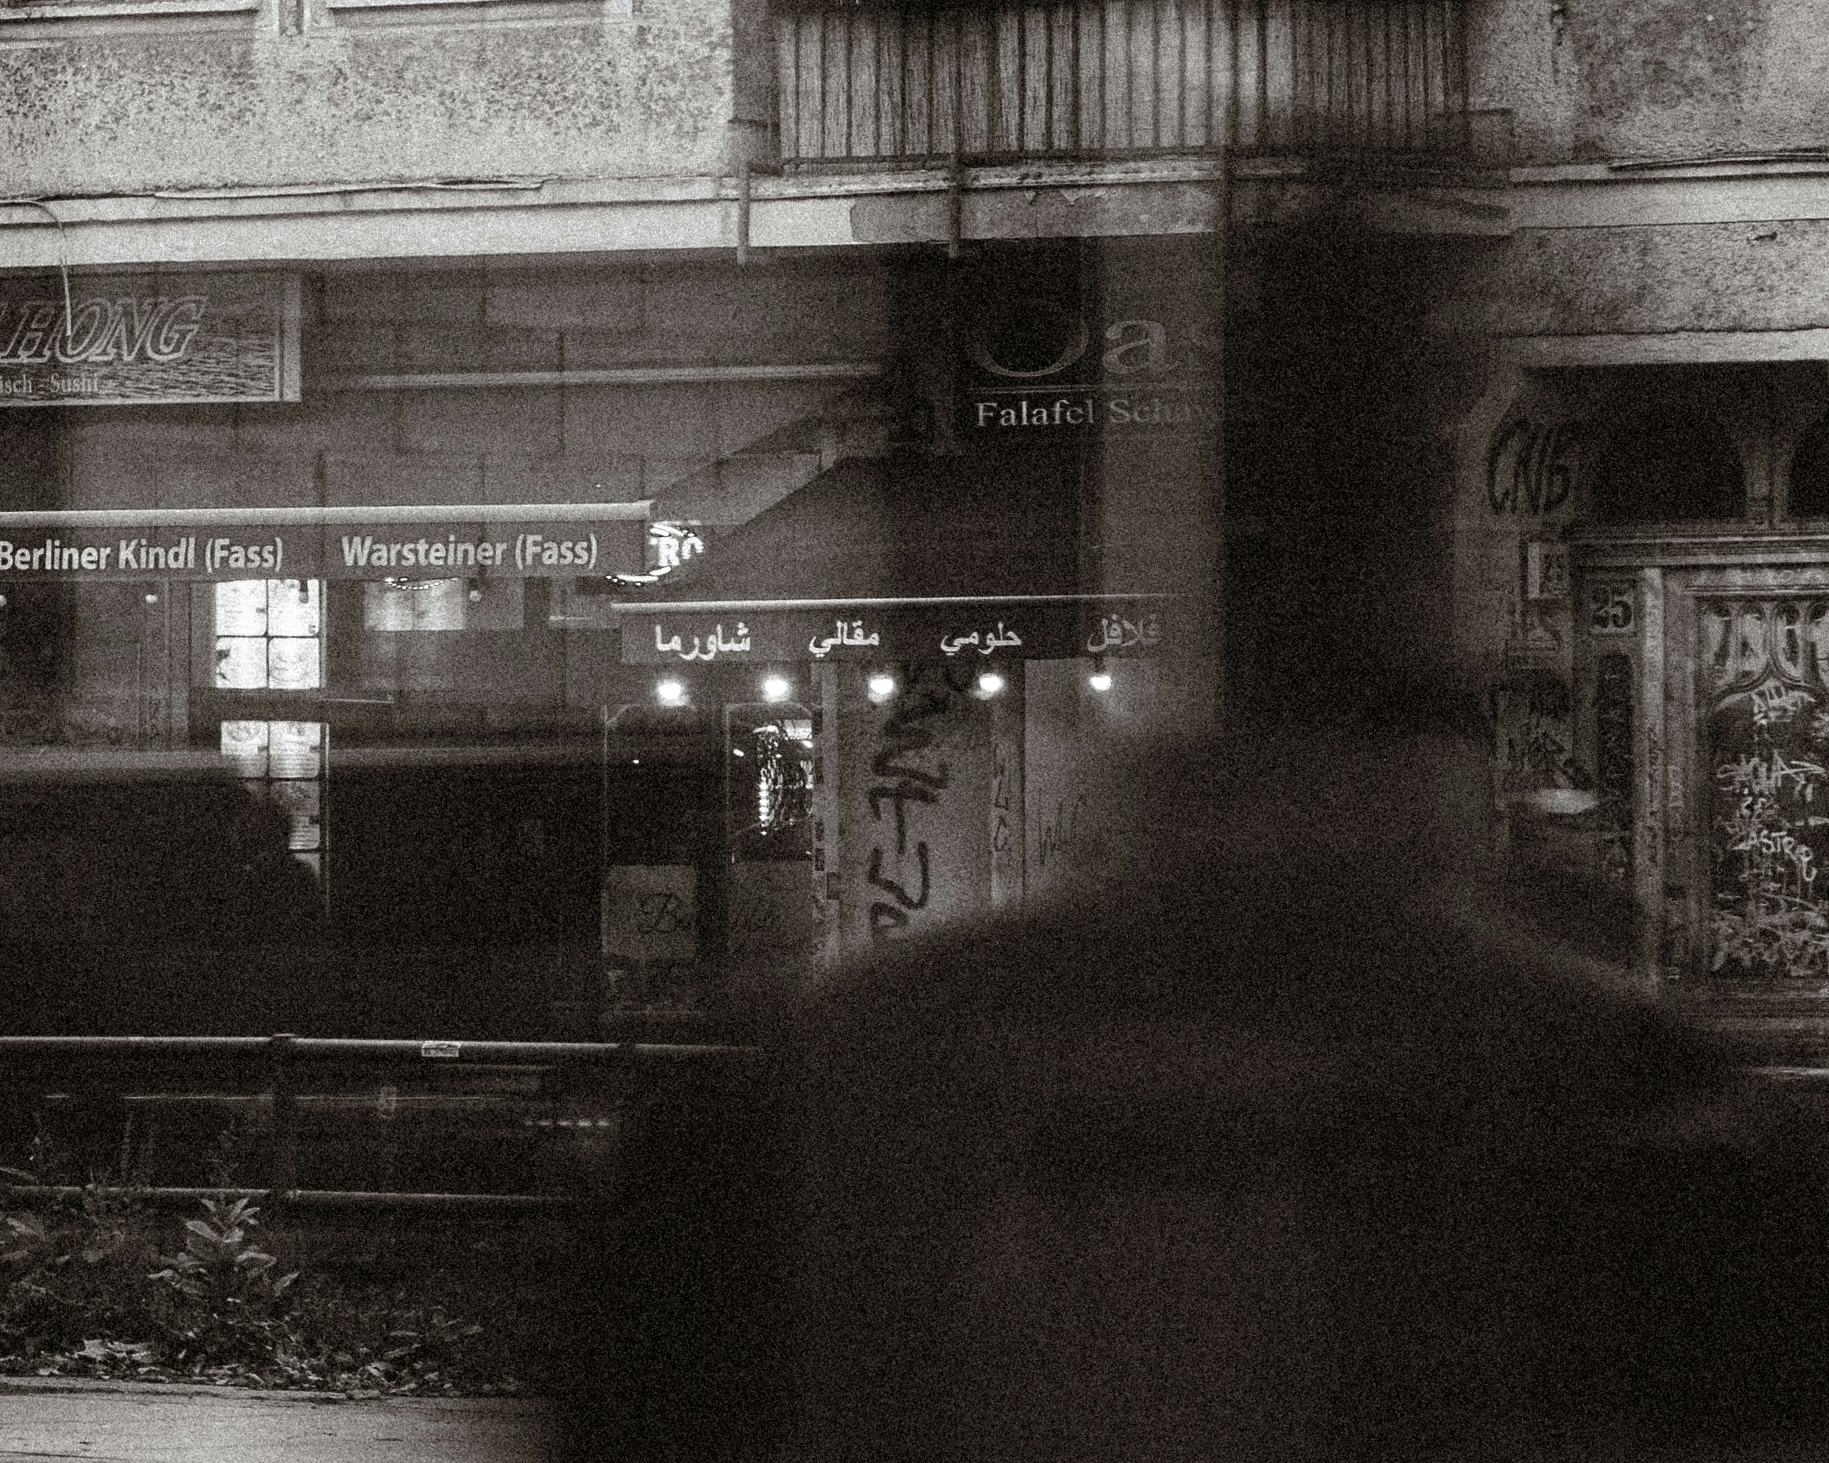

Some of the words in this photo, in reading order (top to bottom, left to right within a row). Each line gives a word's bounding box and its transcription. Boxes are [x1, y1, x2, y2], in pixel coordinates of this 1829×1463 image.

[976, 399, 1094, 427] Falafel
[118, 538, 194, 570] Kindl
[205, 537, 283, 573] (Fass)
[342, 536, 503, 566] Warsteiner
[515, 534, 598, 569] (Fass)
[1593, 595, 1633, 629] 25
[655, 623, 751, 661] شاورما
[809, 620, 880, 656] مقالي
[940, 624, 1022, 655] حلومي
